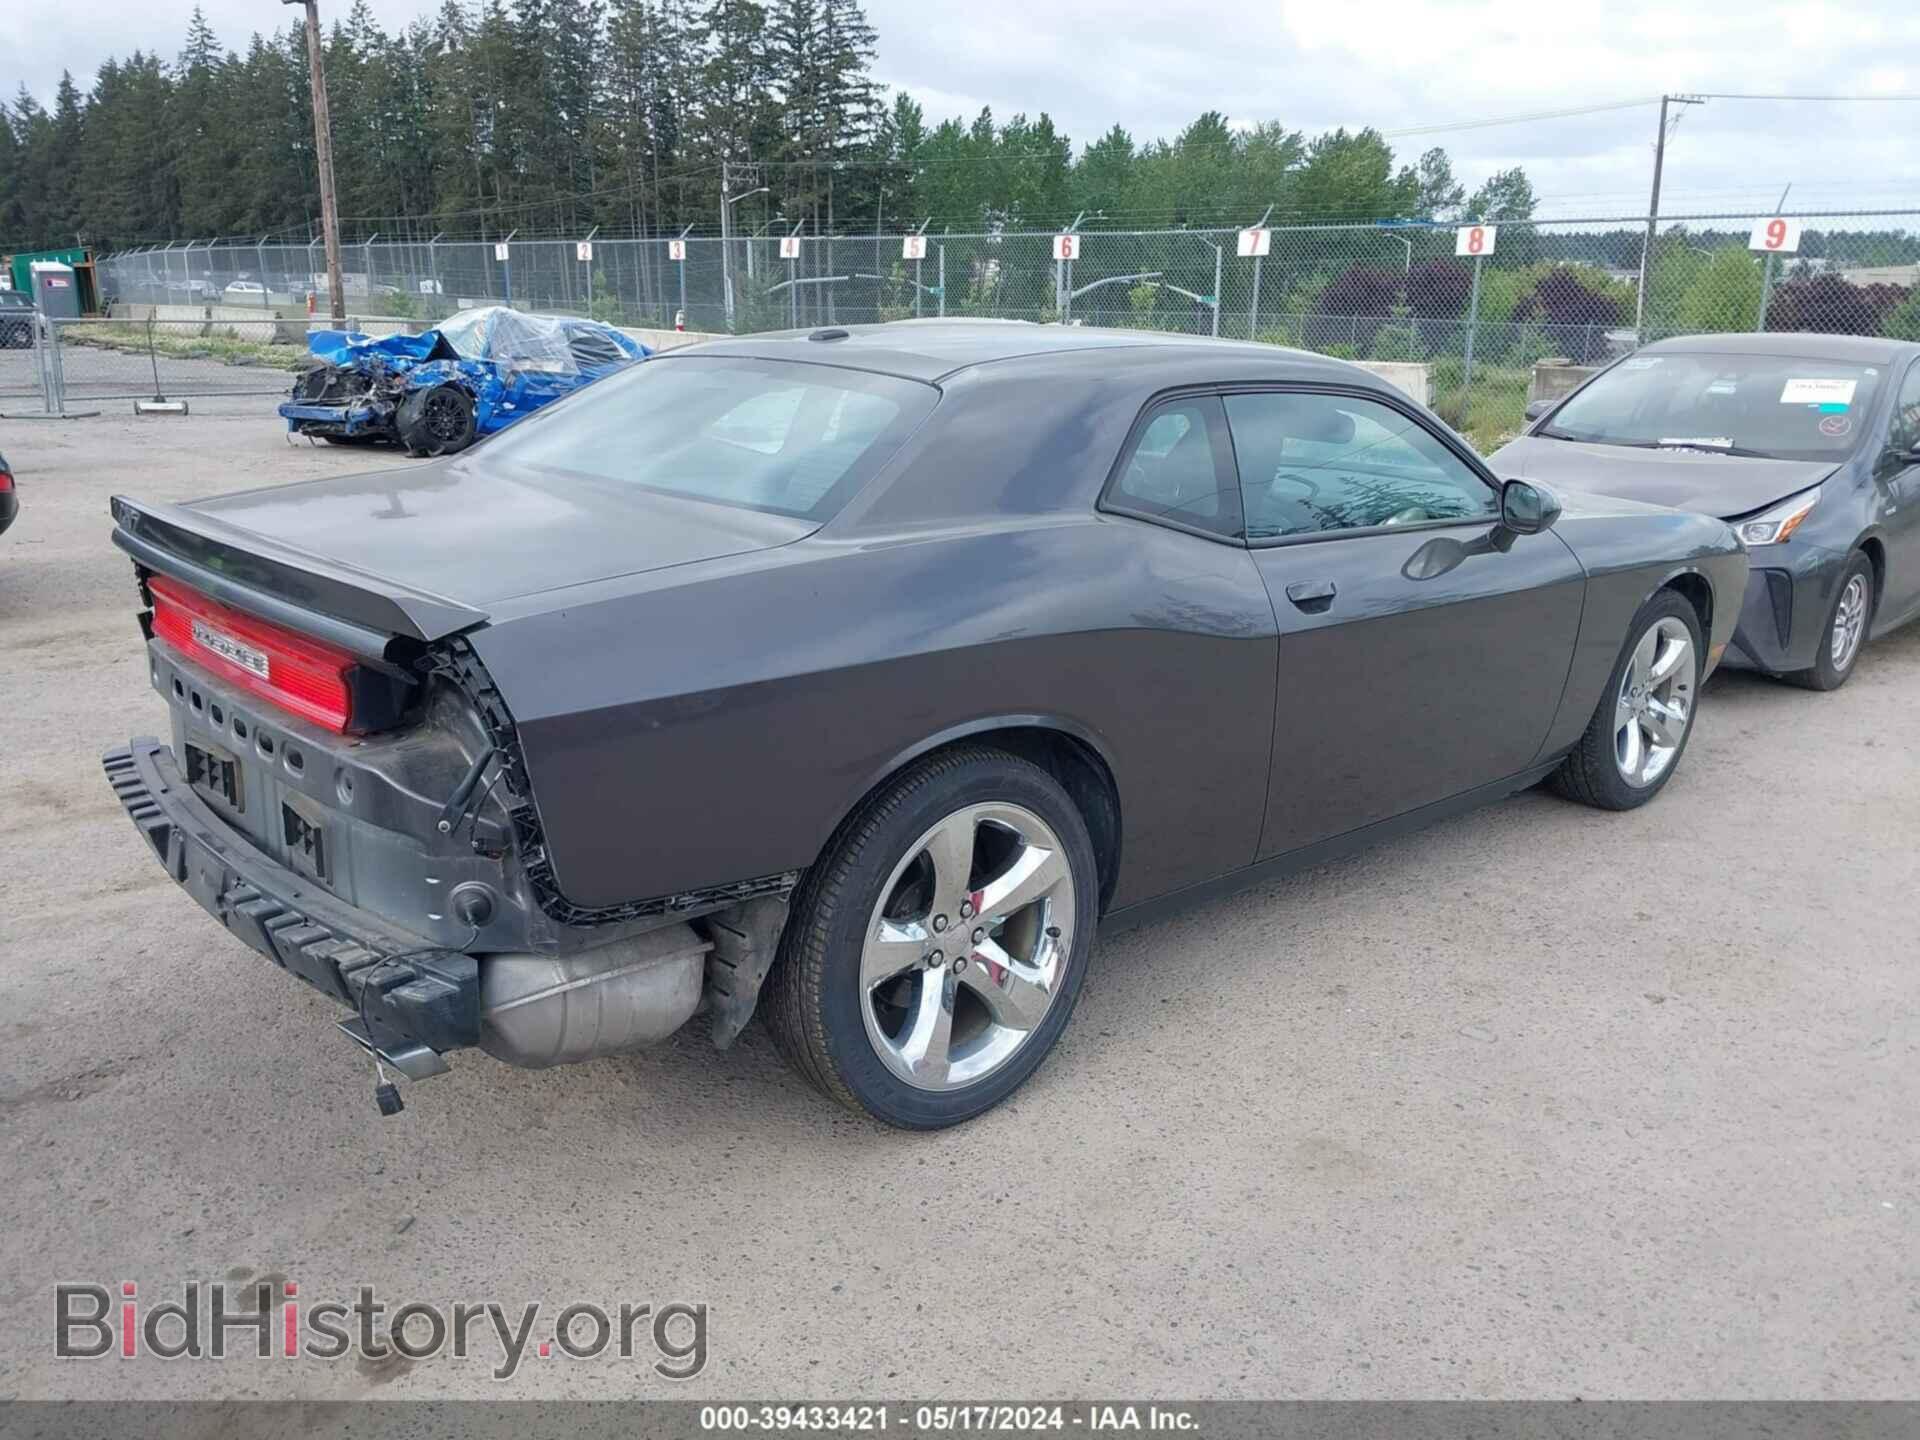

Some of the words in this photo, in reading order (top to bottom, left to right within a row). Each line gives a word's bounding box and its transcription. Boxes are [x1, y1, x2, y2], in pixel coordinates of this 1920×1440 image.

[1250, 230, 1260, 254] 7
[1469, 227, 1484, 253] 8
[1765, 218, 1786, 249] 9
[911, 237, 919, 256] 5
[1062, 236, 1072, 257] 6
